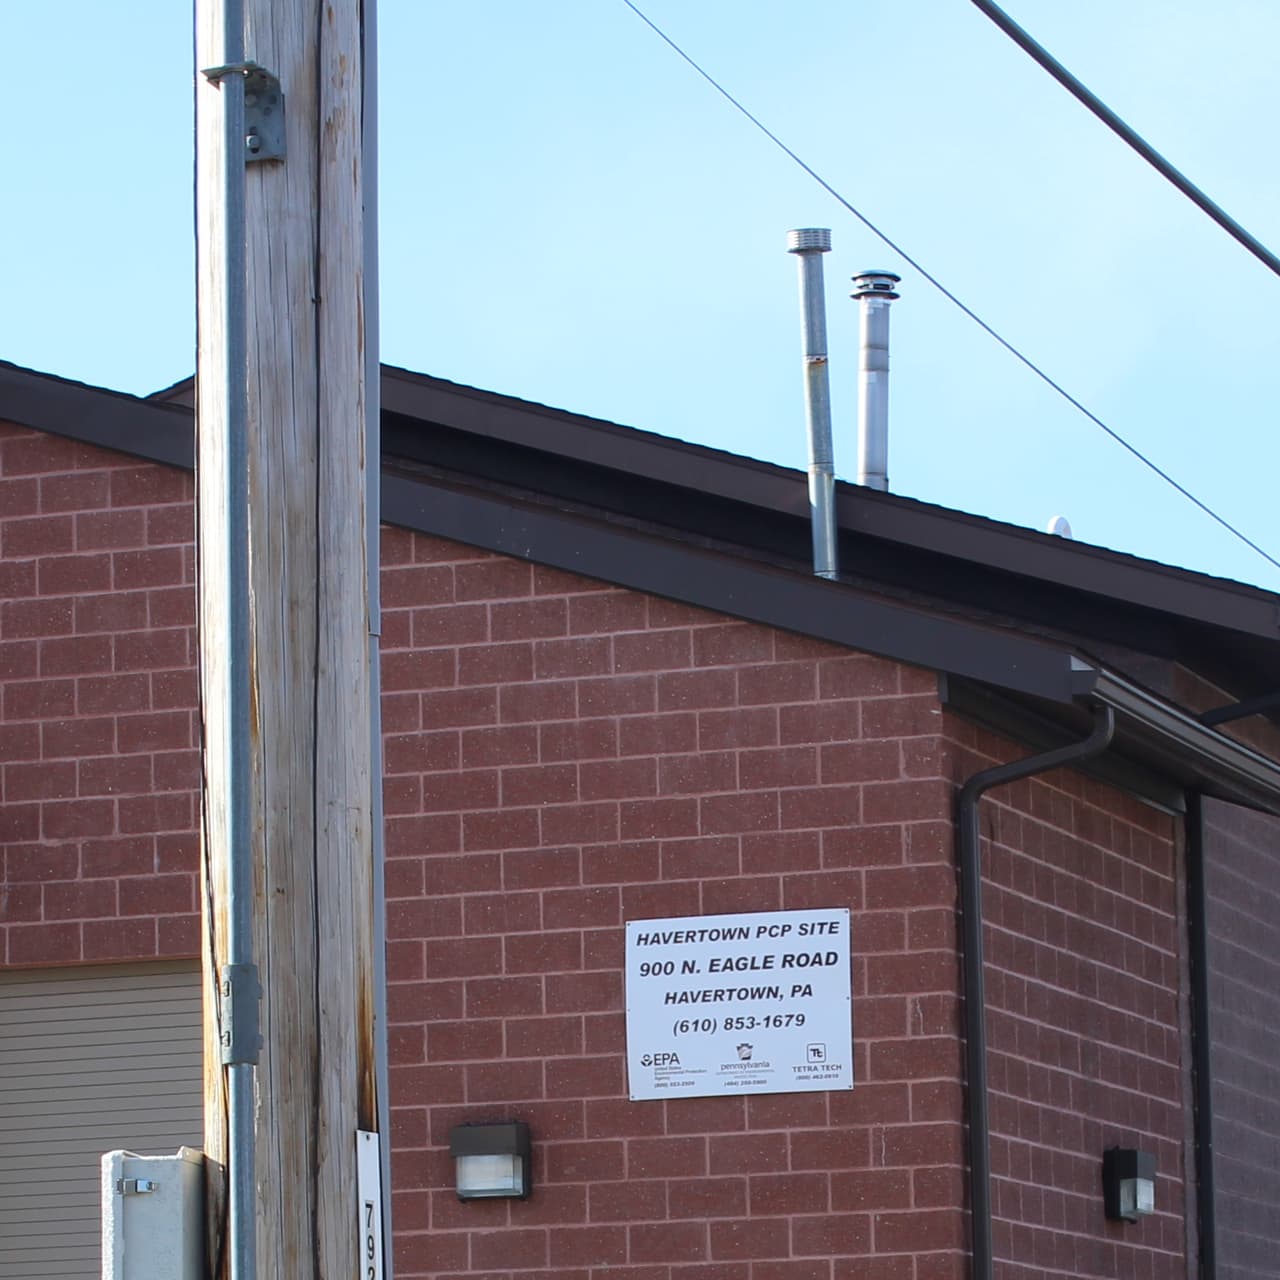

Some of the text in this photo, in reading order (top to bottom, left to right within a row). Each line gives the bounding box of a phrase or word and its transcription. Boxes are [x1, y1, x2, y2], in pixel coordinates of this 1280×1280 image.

[636, 921, 840, 946] HAVERTOWN PCP SITE
[639, 951, 839, 977] 900 N. EAGLE ROAD
[664, 984, 813, 1005] HAVERTOWN, PA
[673, 1014, 806, 1036] (610) 853-1679
[654, 1052, 680, 1066] EPA
[720, 1061, 770, 1071] pennsylvania
[792, 1064, 842, 1073] TETRA TECH
